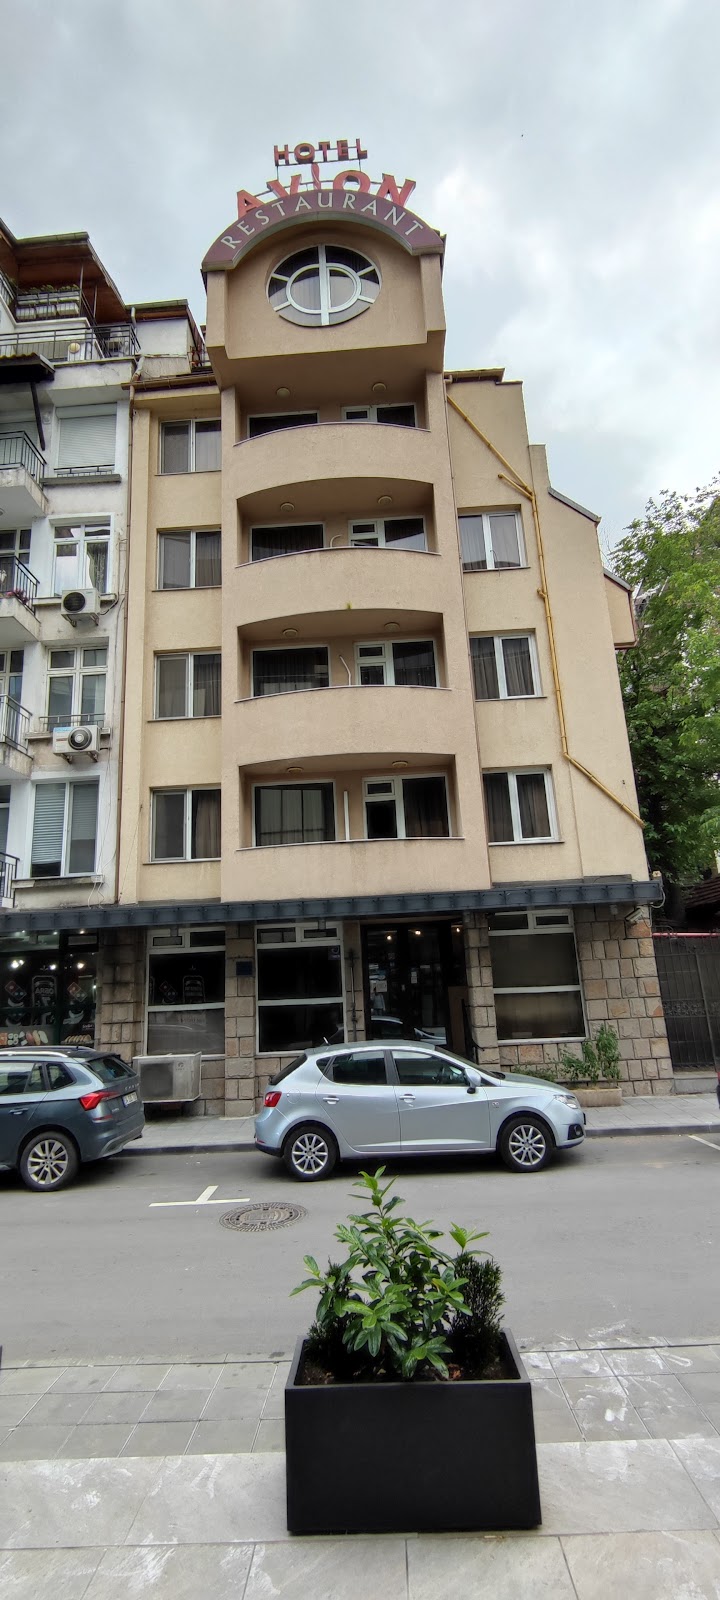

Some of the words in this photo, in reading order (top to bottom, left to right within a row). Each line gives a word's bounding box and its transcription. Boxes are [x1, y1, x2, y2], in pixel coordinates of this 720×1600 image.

[274, 139, 368, 166] HOTEL
[237, 163, 416, 219] AVION
[220, 192, 423, 249] RESTAURANT
